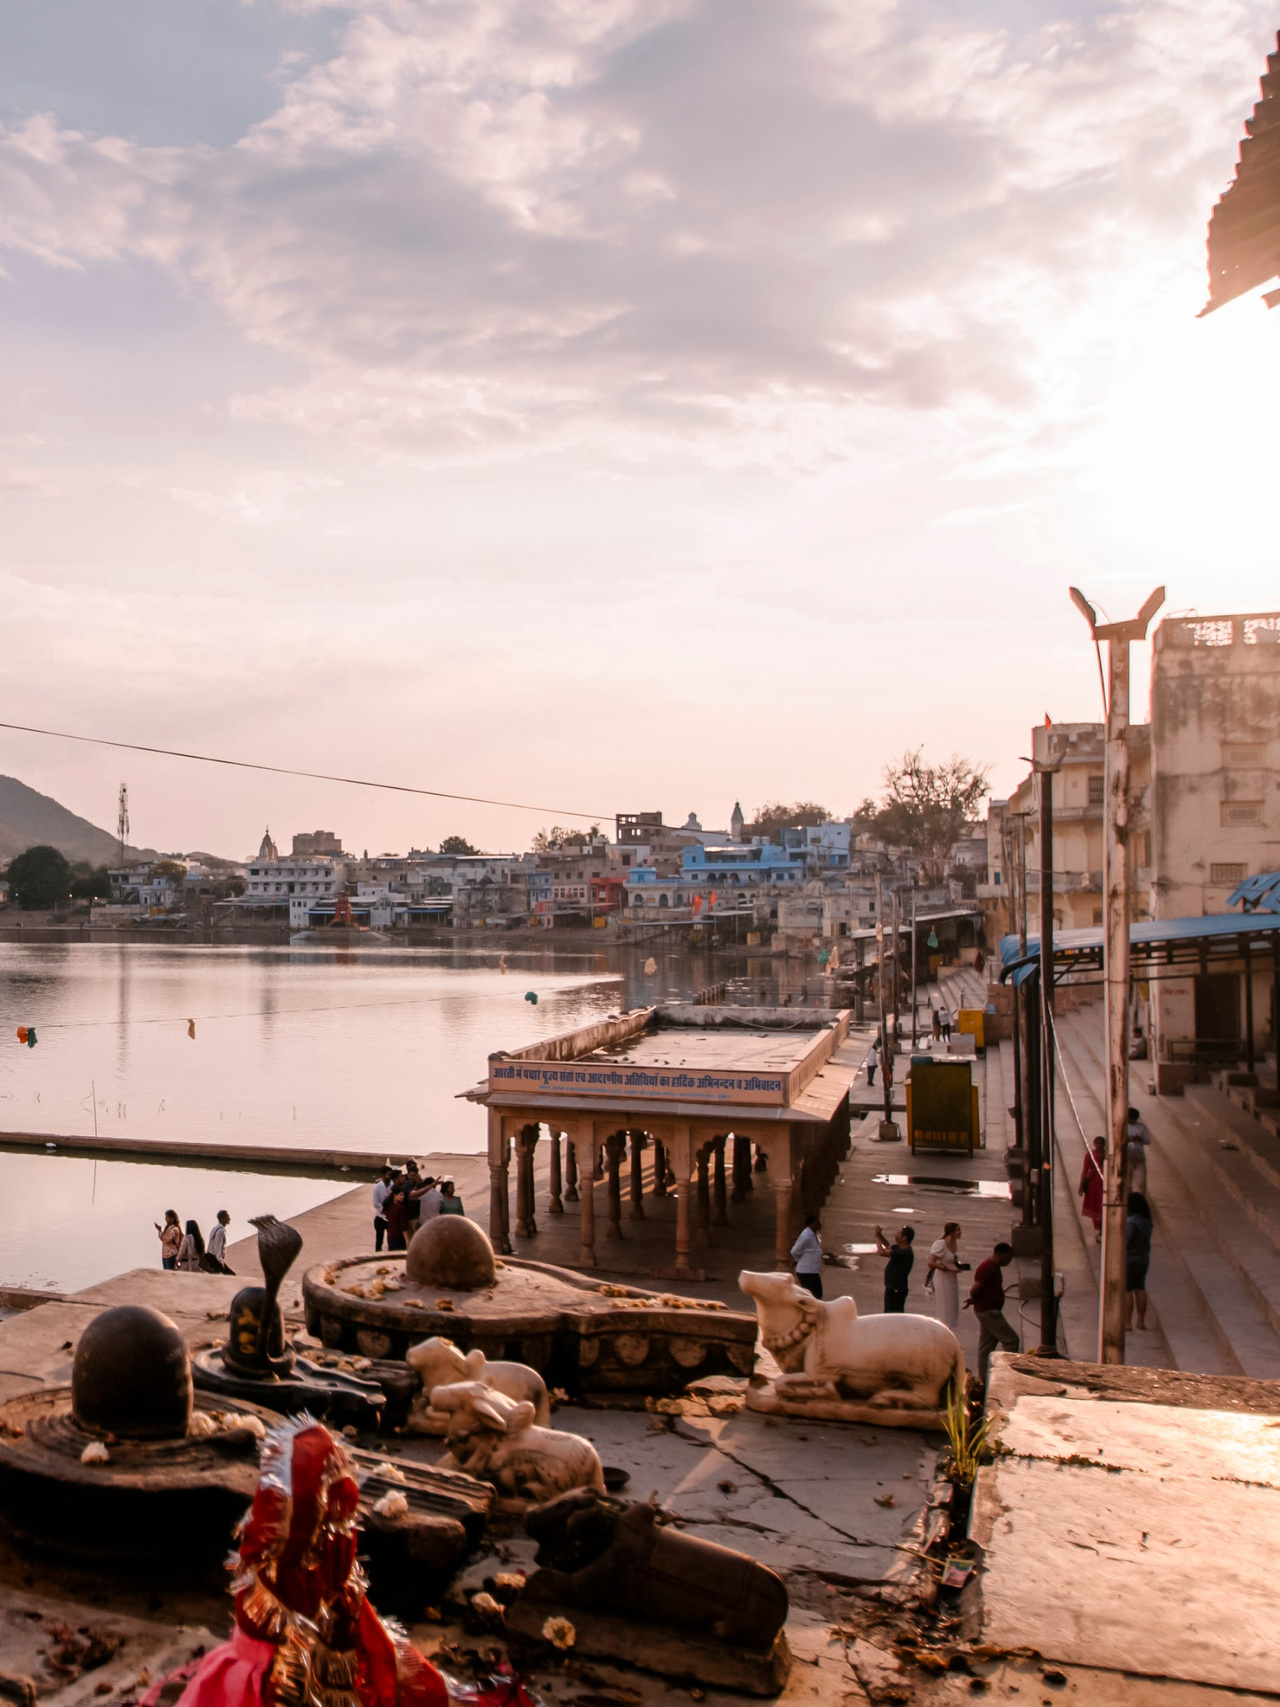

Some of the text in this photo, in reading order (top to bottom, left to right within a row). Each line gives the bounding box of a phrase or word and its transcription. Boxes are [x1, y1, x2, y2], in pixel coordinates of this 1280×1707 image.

[493, 1066, 515, 1079] आरती
[587, 1071, 623, 1084] आदरणीय
[659, 1076, 670, 1087] का
[671, 1074, 696, 1089] हार्दिक
[696, 1074, 735, 1090] अभिनन्दन
[743, 1076, 781, 1092] अभिवादन
